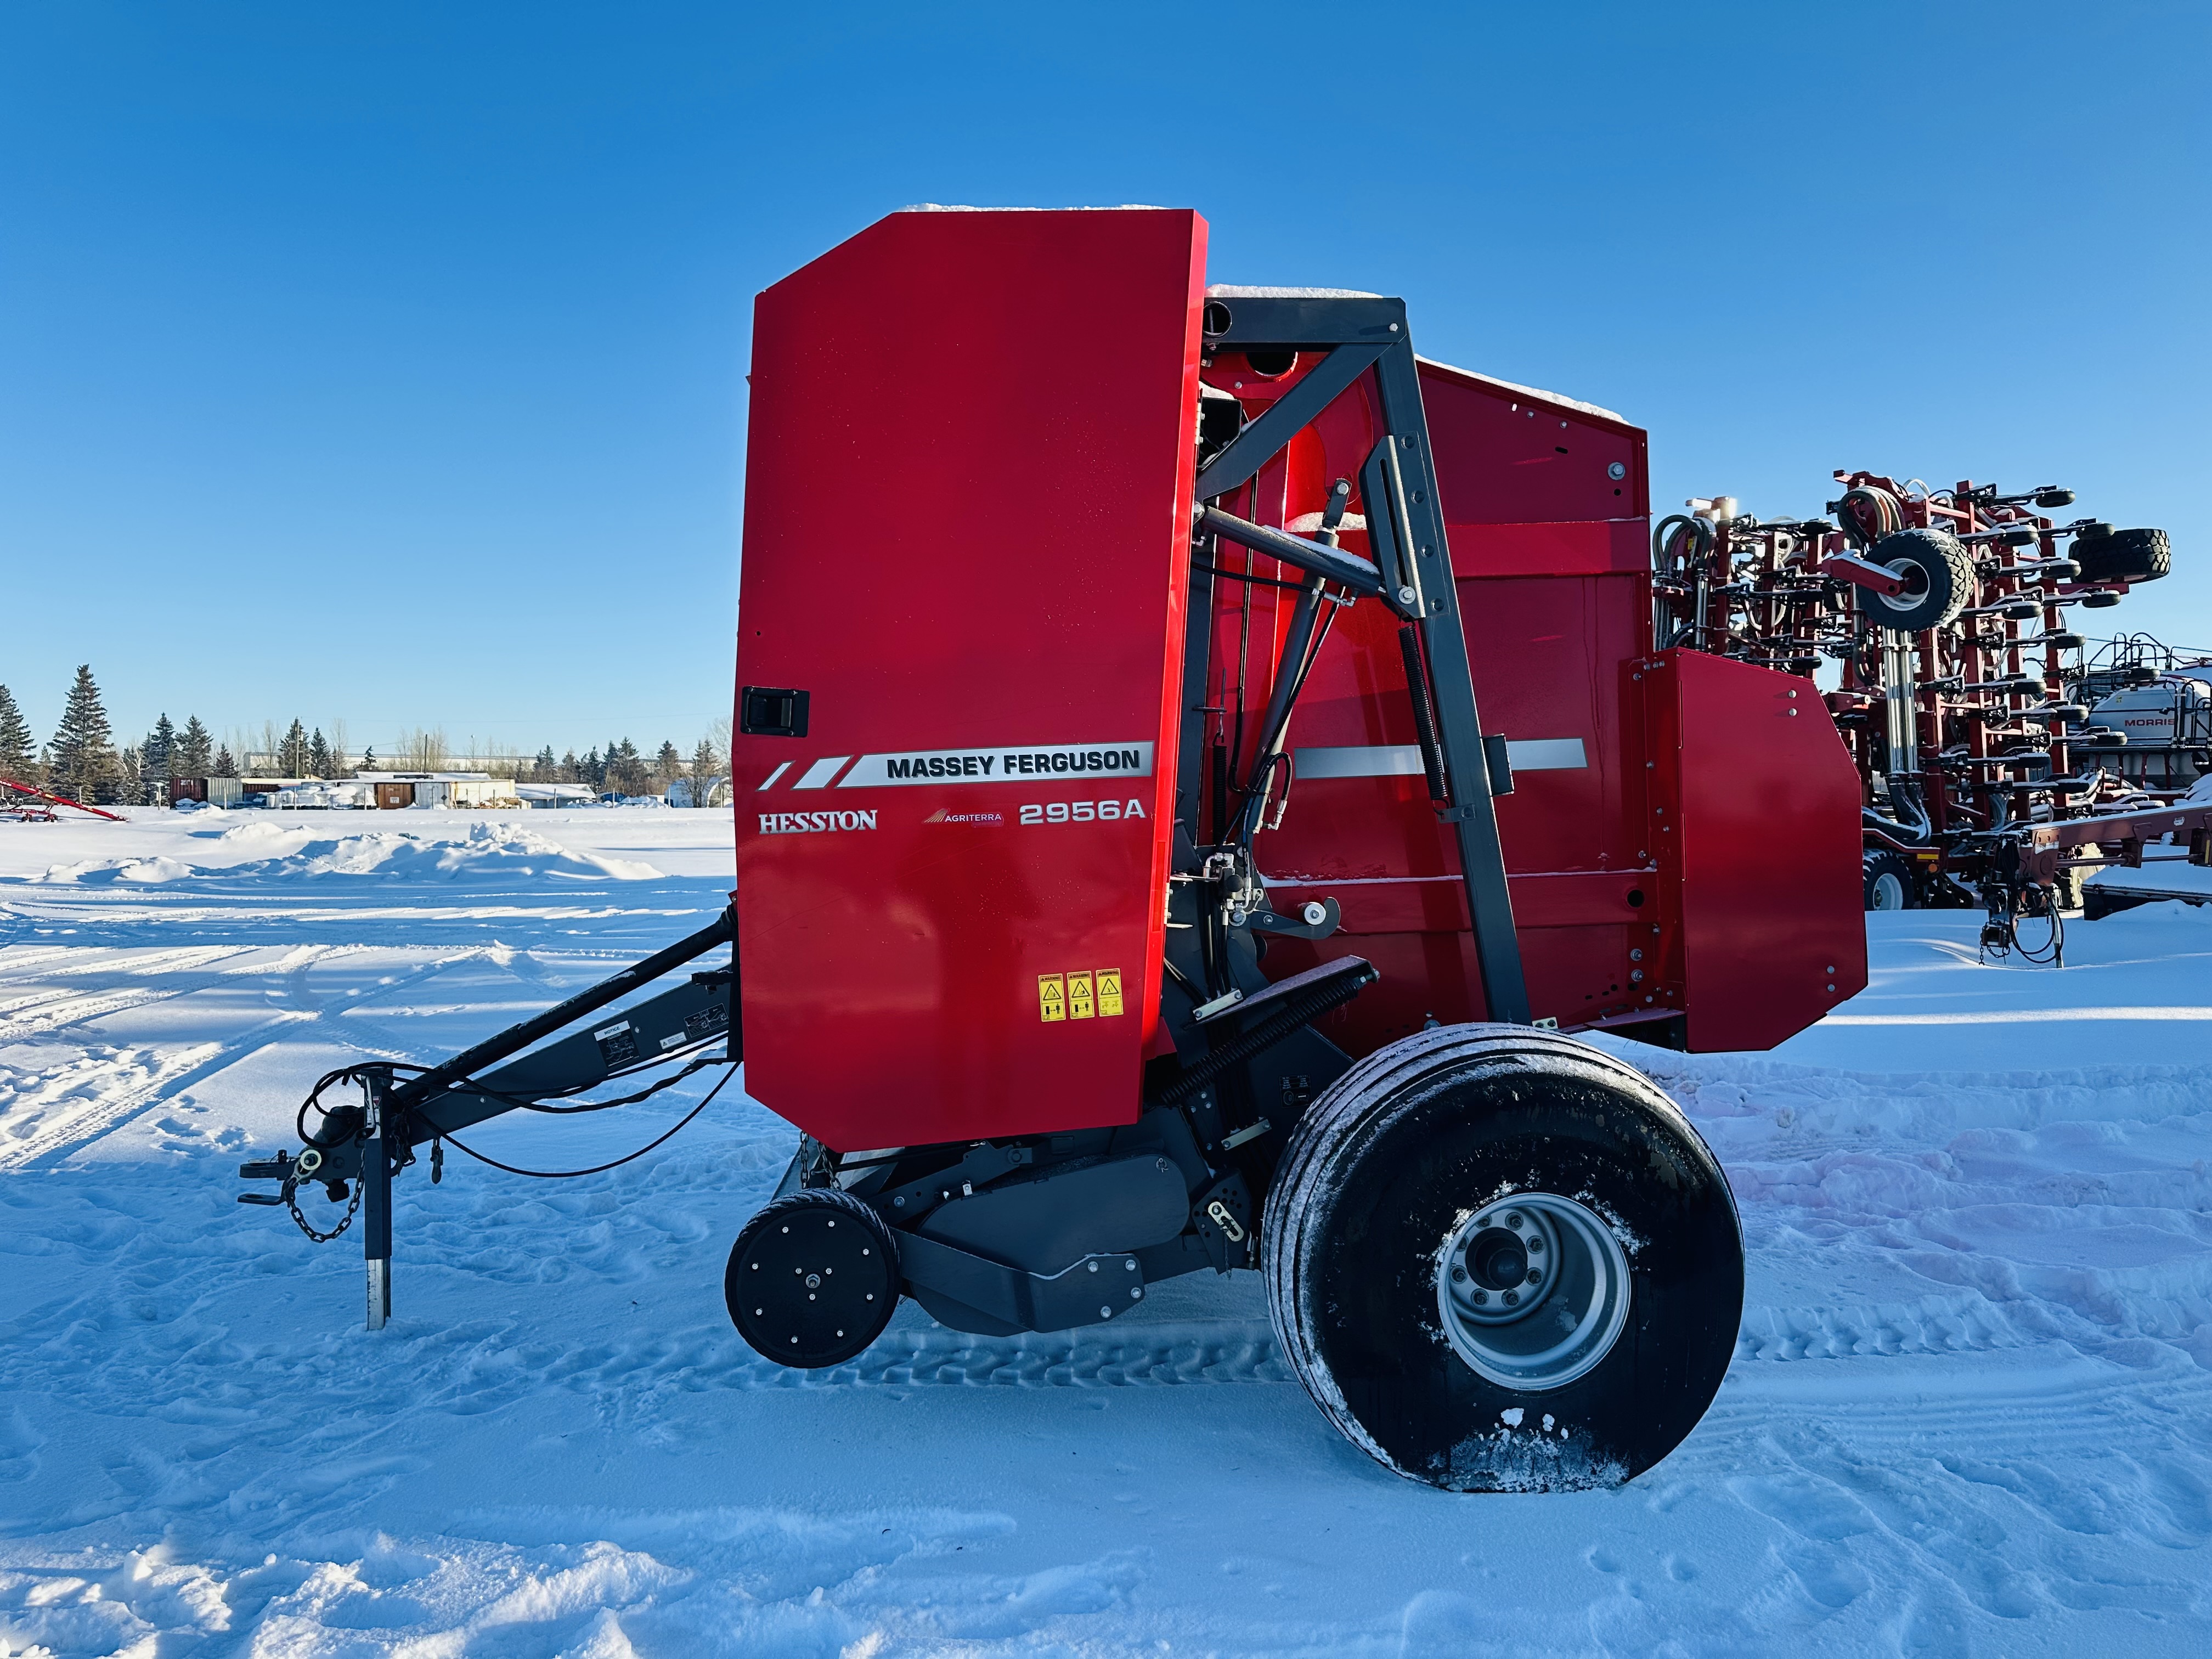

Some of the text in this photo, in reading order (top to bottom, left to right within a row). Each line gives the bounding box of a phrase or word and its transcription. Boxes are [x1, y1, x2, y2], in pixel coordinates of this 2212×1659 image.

[887, 750, 1141, 778] MASSEY FERGUSON
[758, 809, 877, 834] HESSTON
[945, 814, 1002, 822] AGRITERRA
[1019, 799, 1147, 825] 2956A
[604, 1026, 620, 1035] NOTICE
